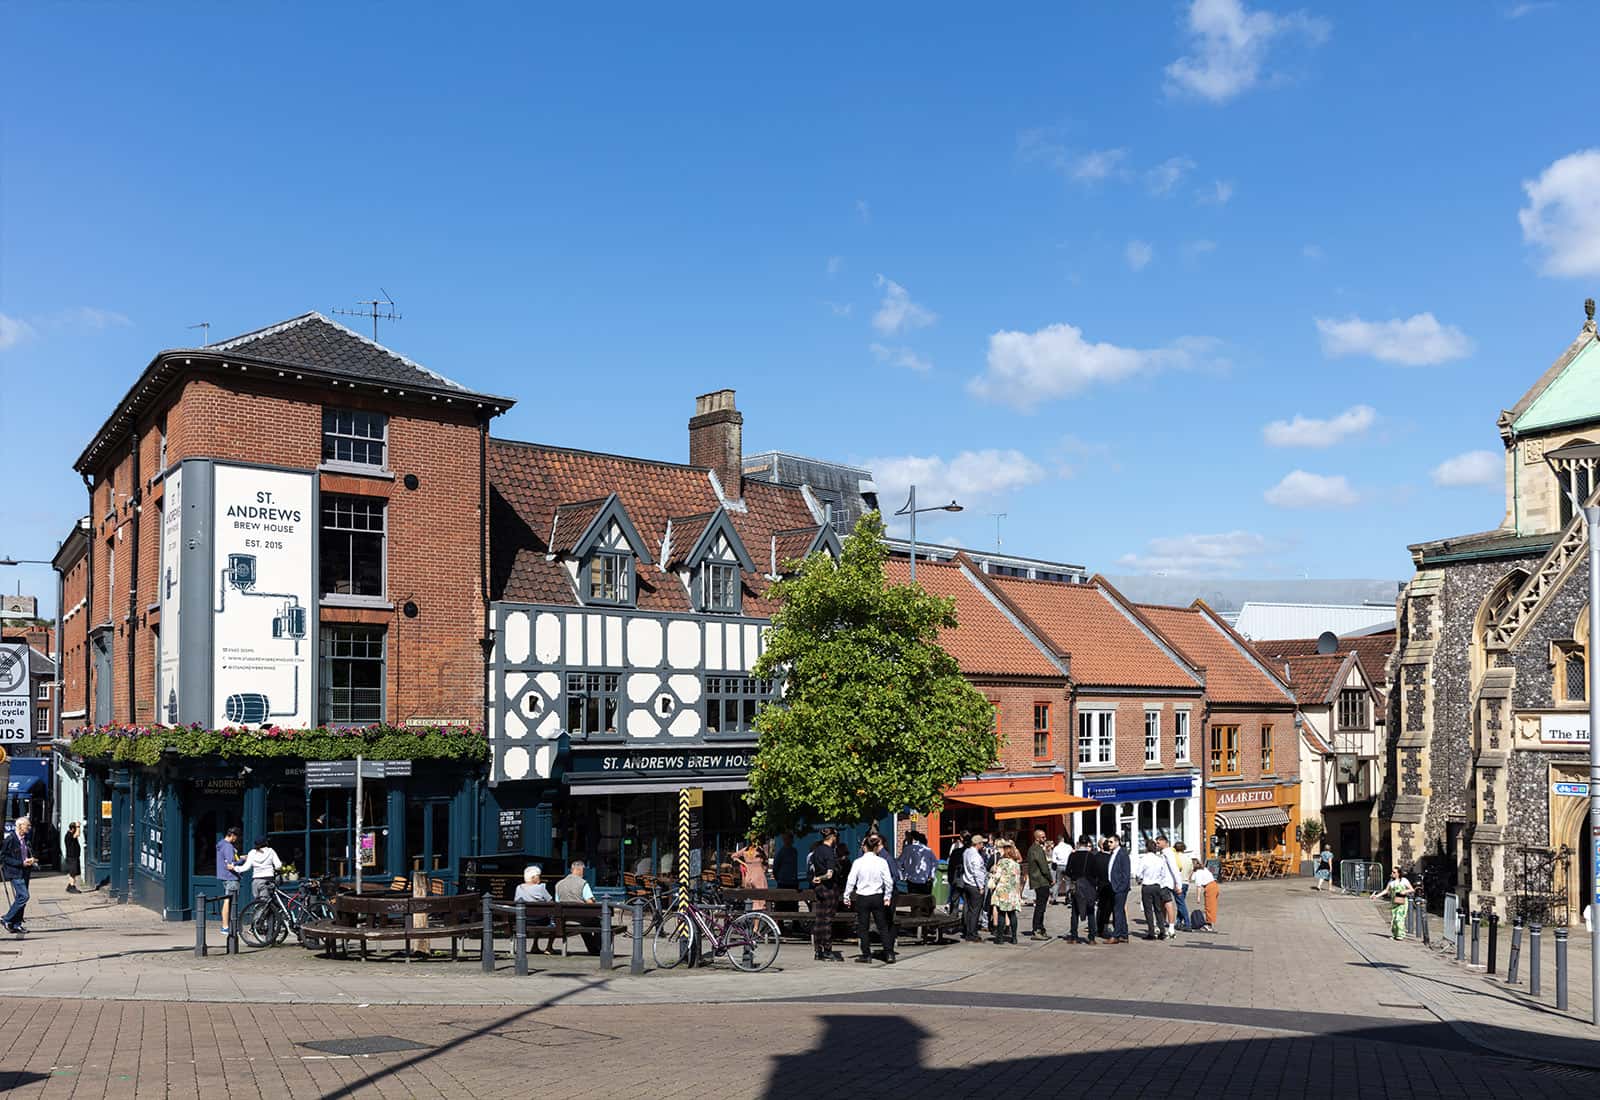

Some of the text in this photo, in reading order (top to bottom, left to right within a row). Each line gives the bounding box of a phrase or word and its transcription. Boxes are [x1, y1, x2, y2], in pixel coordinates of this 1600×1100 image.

[256, 491, 275, 504] ST.
[226, 505, 302, 522] ANDREWS
[233, 521, 295, 533] BREW HOUSE
[245, 539, 283, 549] EST. 2015
[0, 699, 27, 707] strian
[2, 709, 24, 717] cycle
[1549, 729, 1572, 739] The
[602, 756, 619, 770] ST.
[623, 756, 685, 770] ANDREWS
[687, 755, 722, 769] BREW
[1216, 790, 1273, 805] AMARETTO
